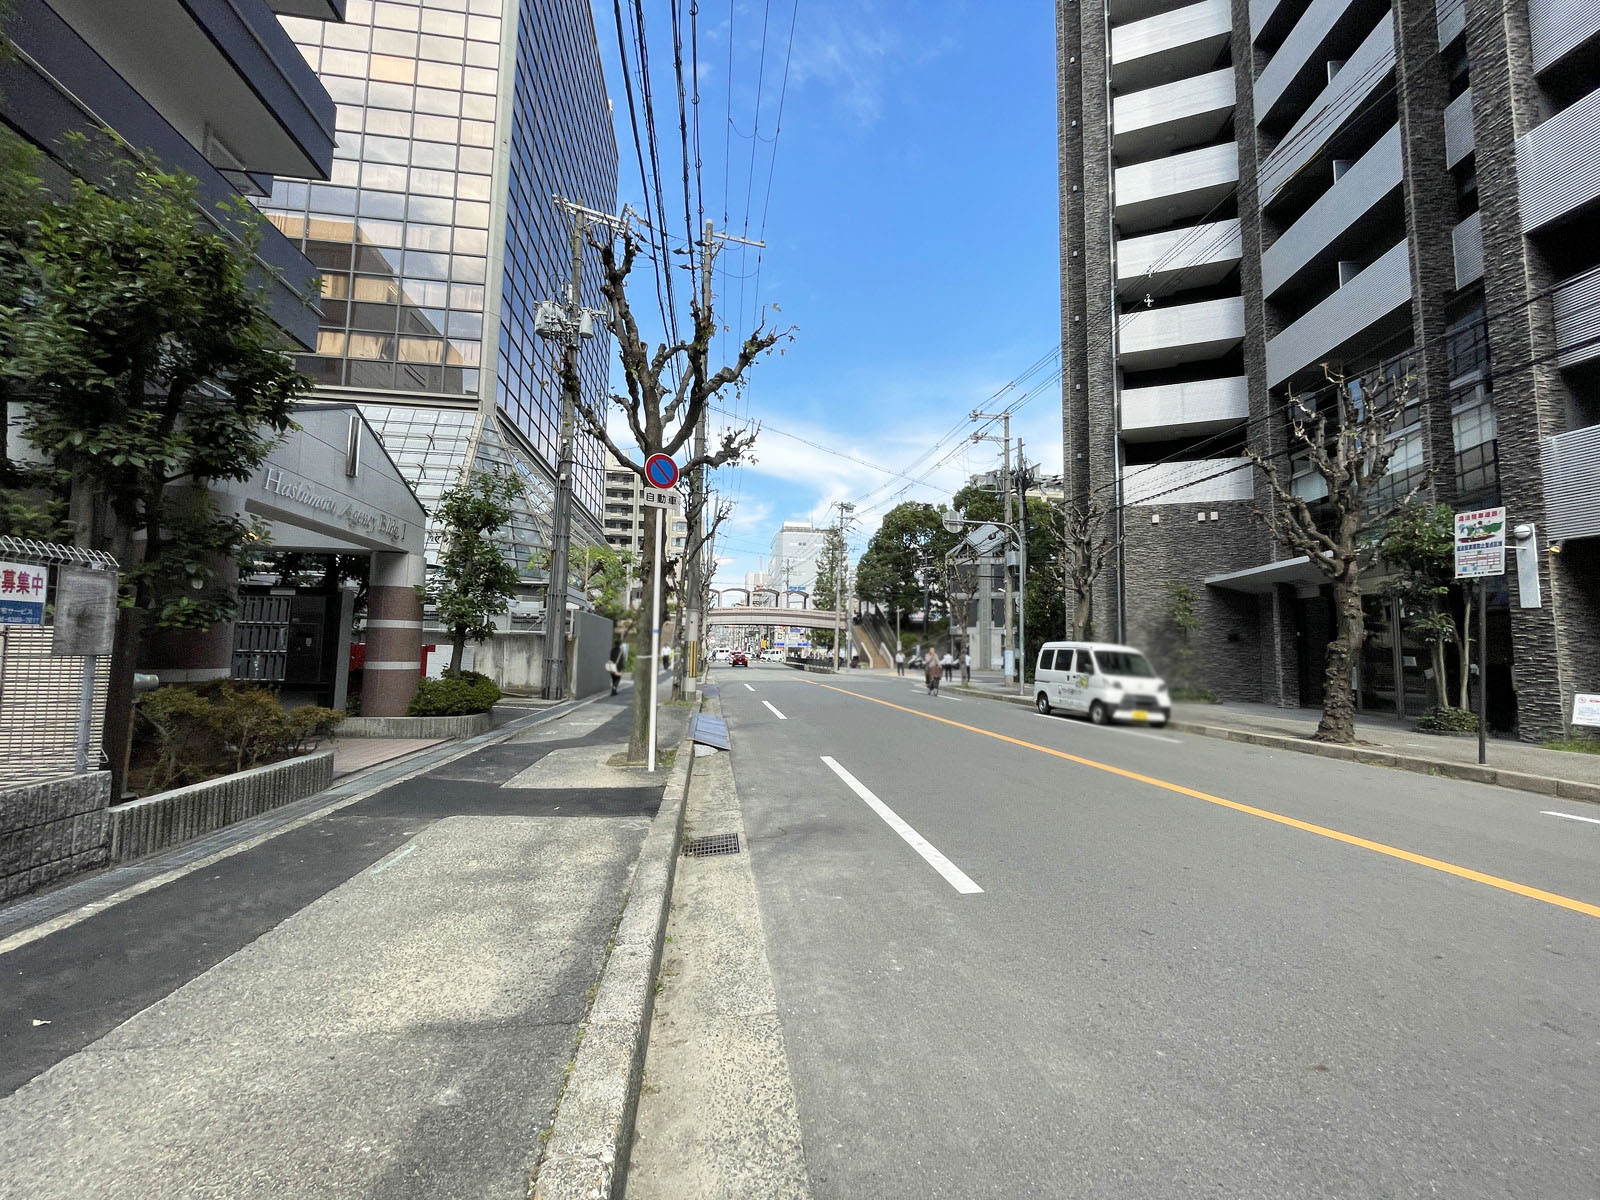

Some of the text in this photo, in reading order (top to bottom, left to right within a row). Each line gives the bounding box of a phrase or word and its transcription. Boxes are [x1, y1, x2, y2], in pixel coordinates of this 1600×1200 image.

[646, 492, 676, 505] 自動車
[2, 569, 43, 596] 募集中
